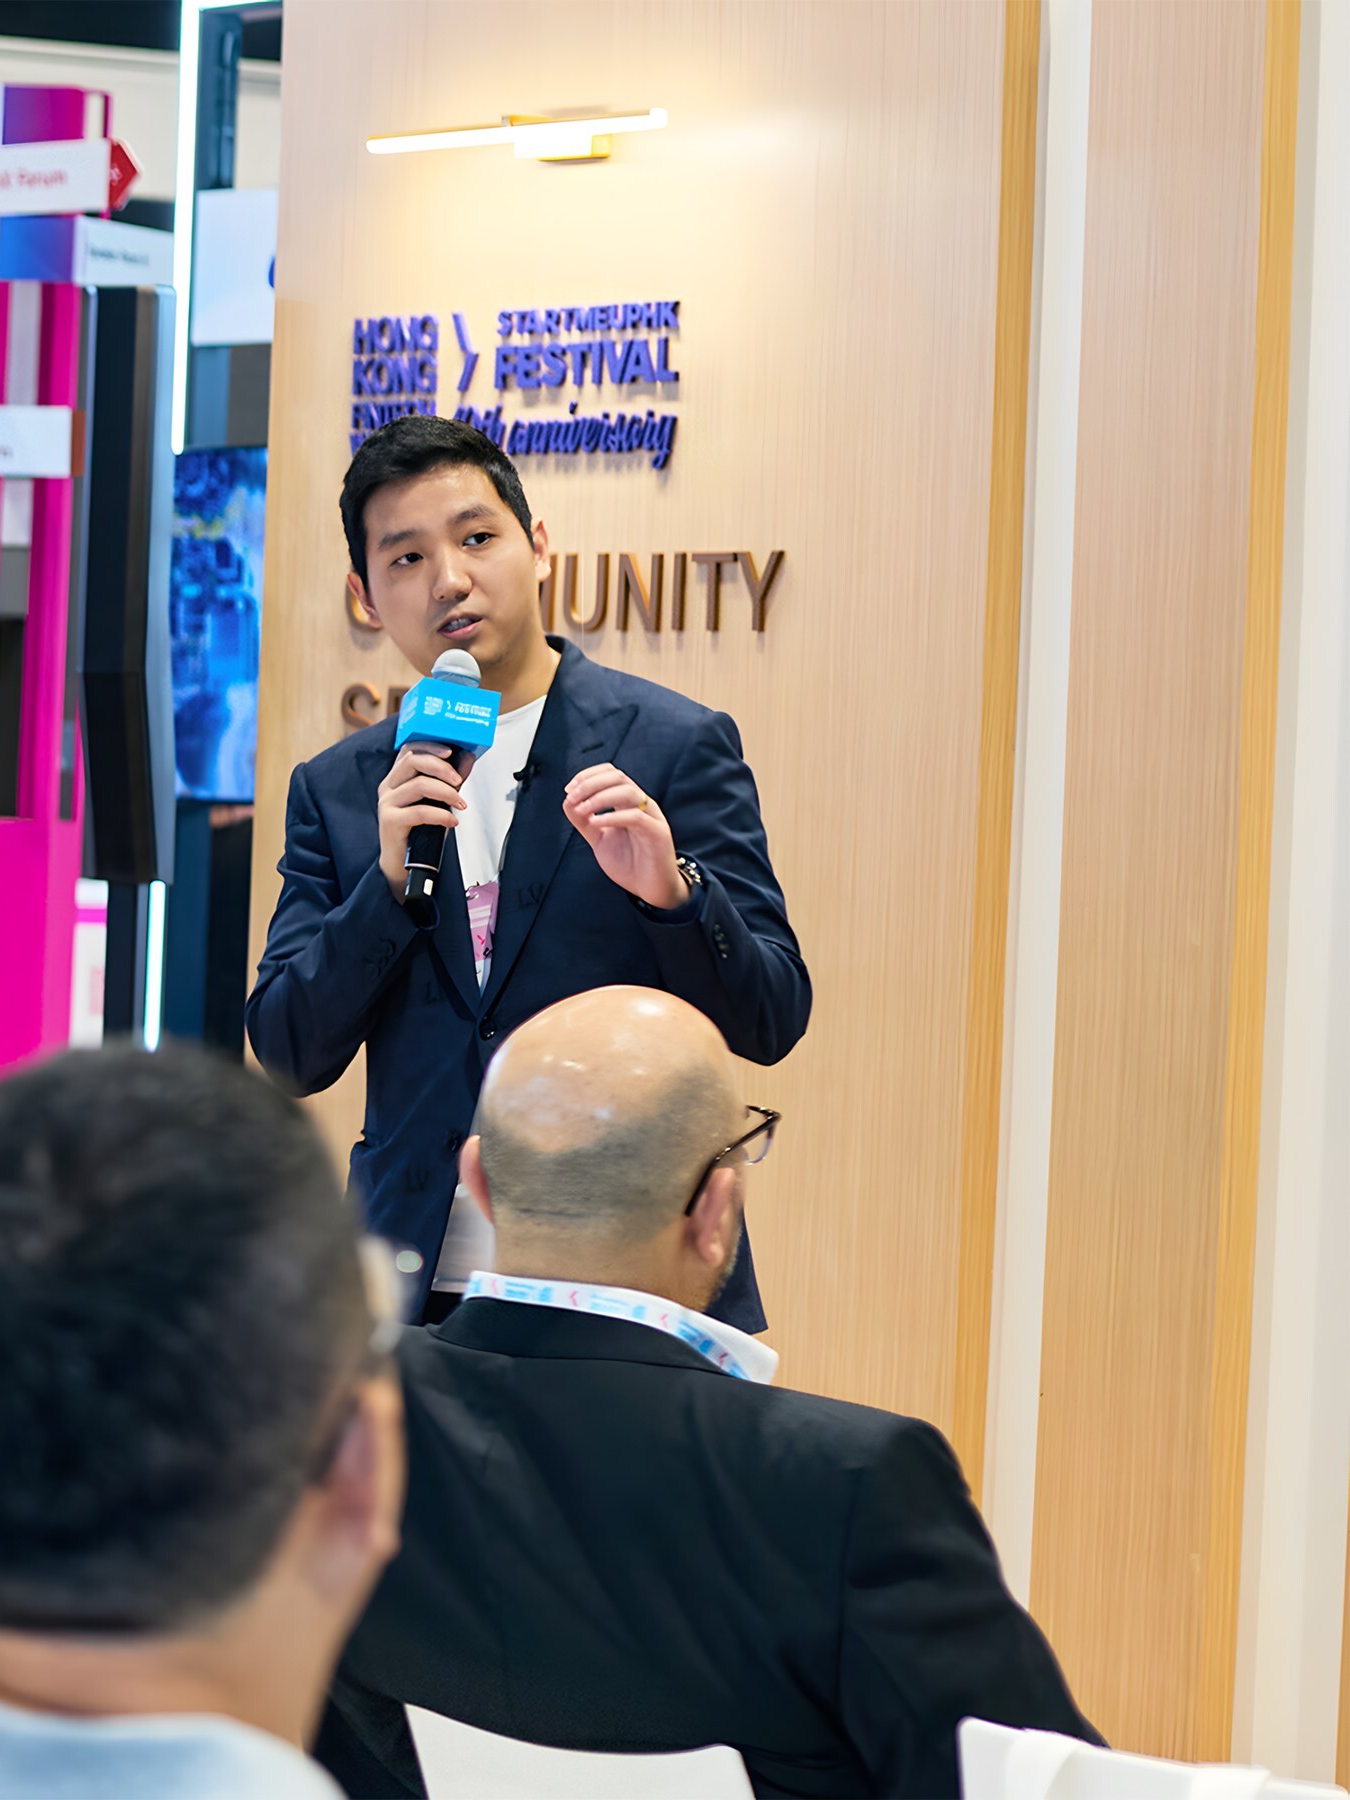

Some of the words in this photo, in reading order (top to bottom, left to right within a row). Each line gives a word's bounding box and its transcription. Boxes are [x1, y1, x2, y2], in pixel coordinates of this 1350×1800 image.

[353, 316, 438, 355] HONG
[498, 302, 680, 336] STARTMEUPHK
[352, 354, 438, 396] KONG
[495, 338, 680, 390] FESTIVAL
[346, 551, 785, 633] UNITY
